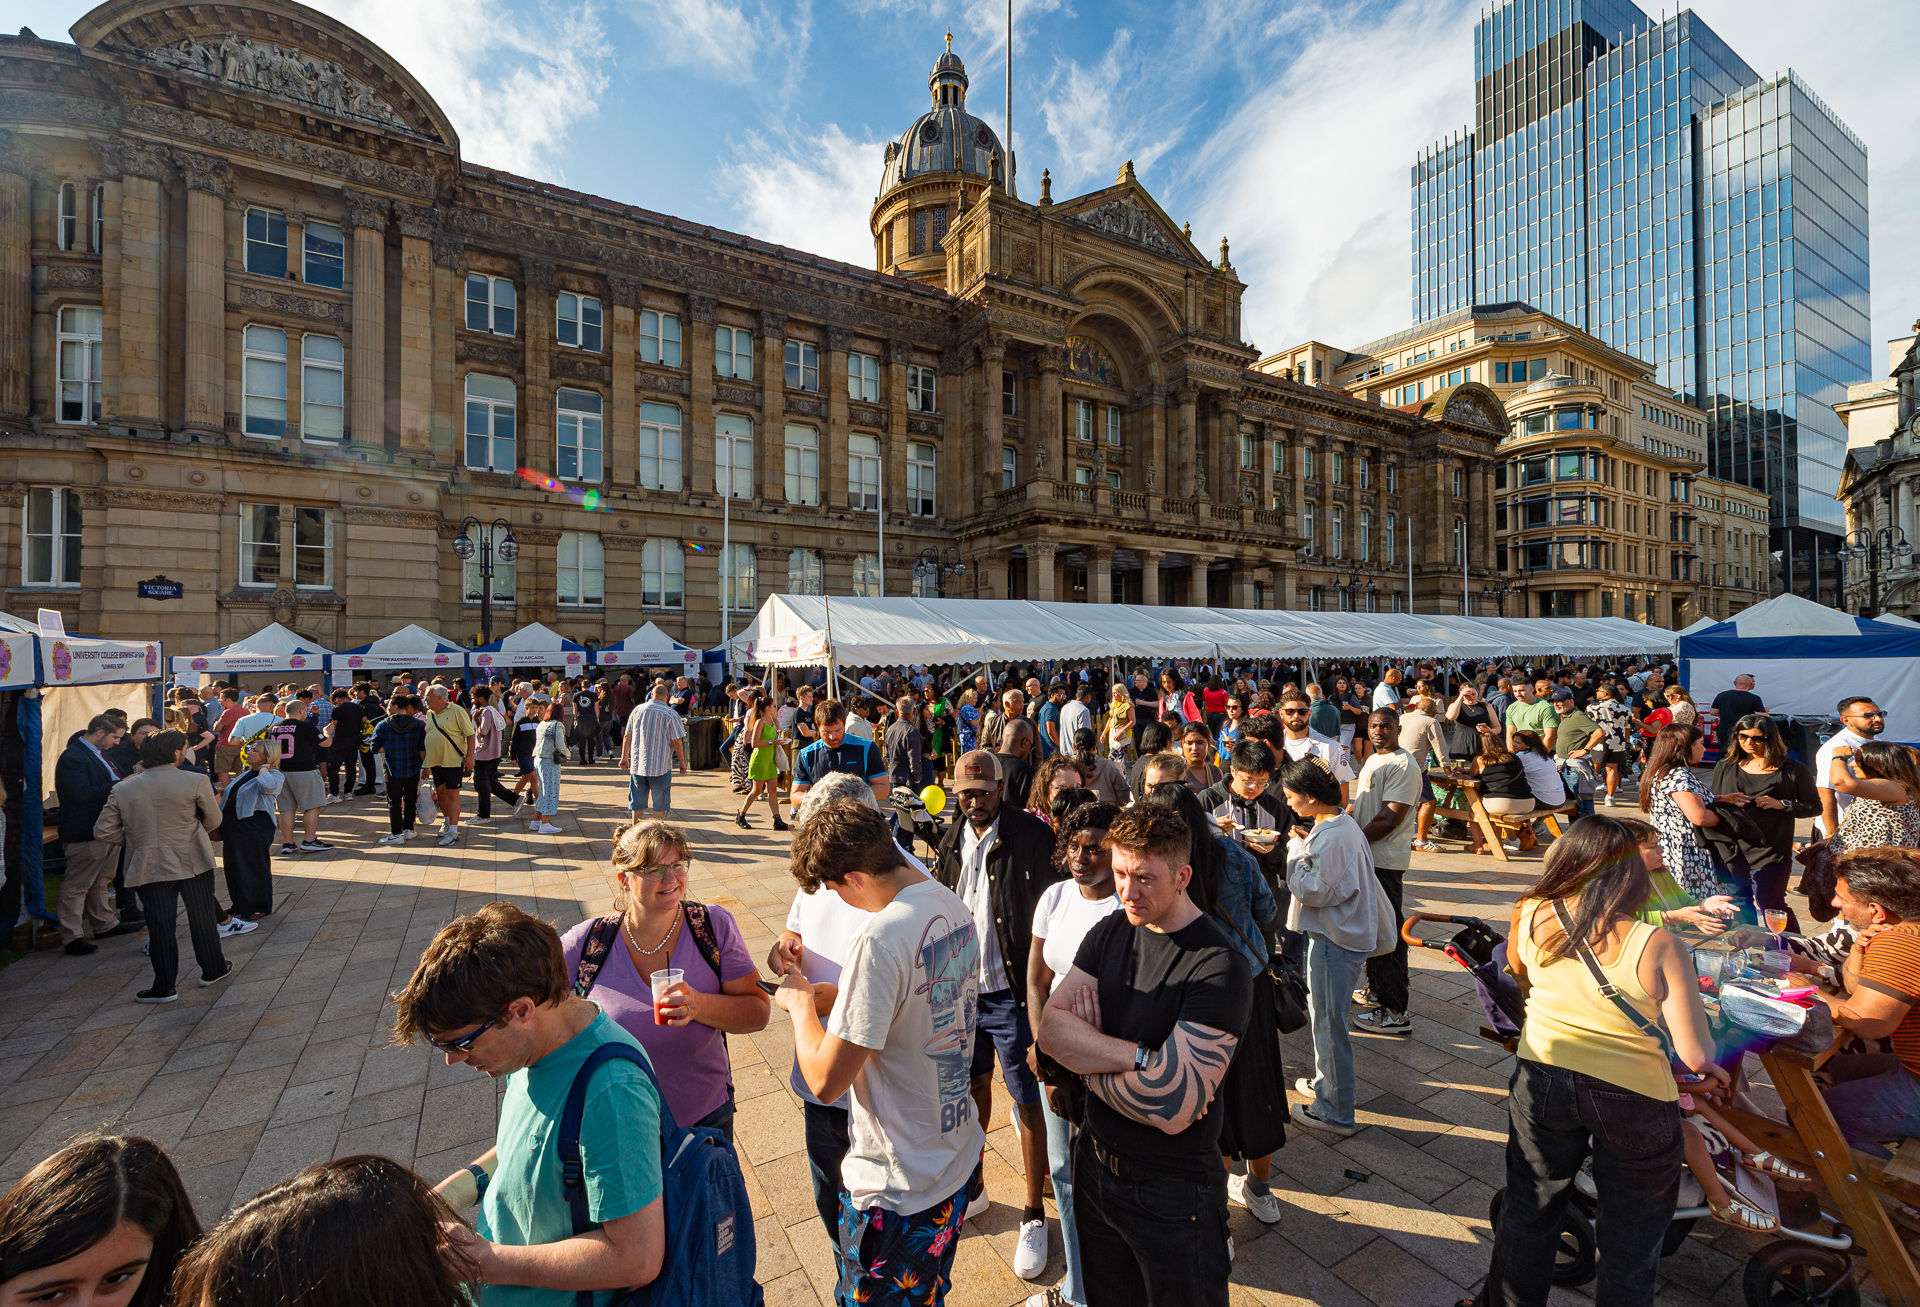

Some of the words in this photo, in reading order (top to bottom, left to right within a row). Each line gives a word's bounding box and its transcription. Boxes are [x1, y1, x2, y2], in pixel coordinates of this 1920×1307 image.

[72, 651, 100, 659] UNIVERSITY
[101, 651, 119, 659] COLLEGE
[271, 725, 297, 733] MESSI
